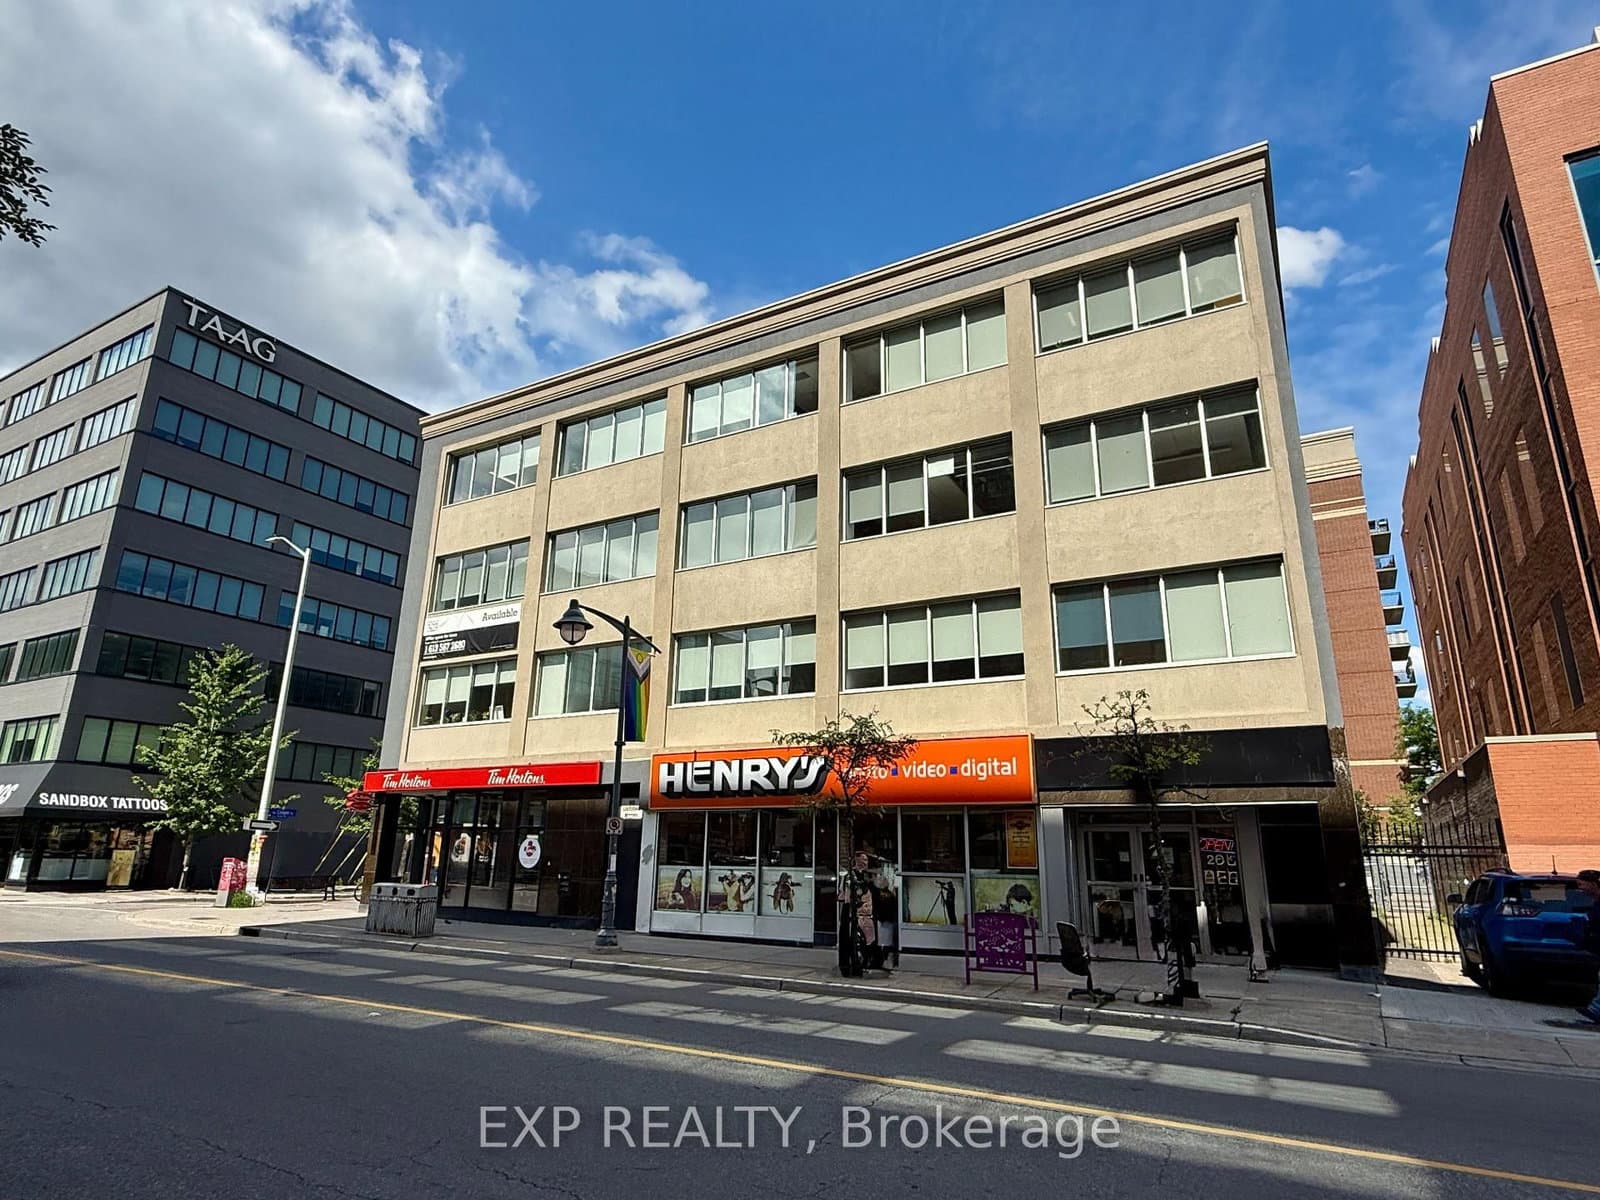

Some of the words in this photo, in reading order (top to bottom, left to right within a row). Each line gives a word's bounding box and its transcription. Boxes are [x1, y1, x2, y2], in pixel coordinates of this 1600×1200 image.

[183, 299, 277, 363] TAAG
[482, 607, 518, 621] Available
[487, 768, 506, 785] Tim
[505, 767, 545, 785] Hortons
[658, 755, 826, 796] HENRY'S
[902, 760, 945, 778] video
[960, 756, 1018, 781] digital
[382, 773, 398, 789] Tim
[398, 772, 432, 789] Hortons
[39, 792, 108, 808] SANDBOX
[111, 796, 169, 811] TATTOOS
